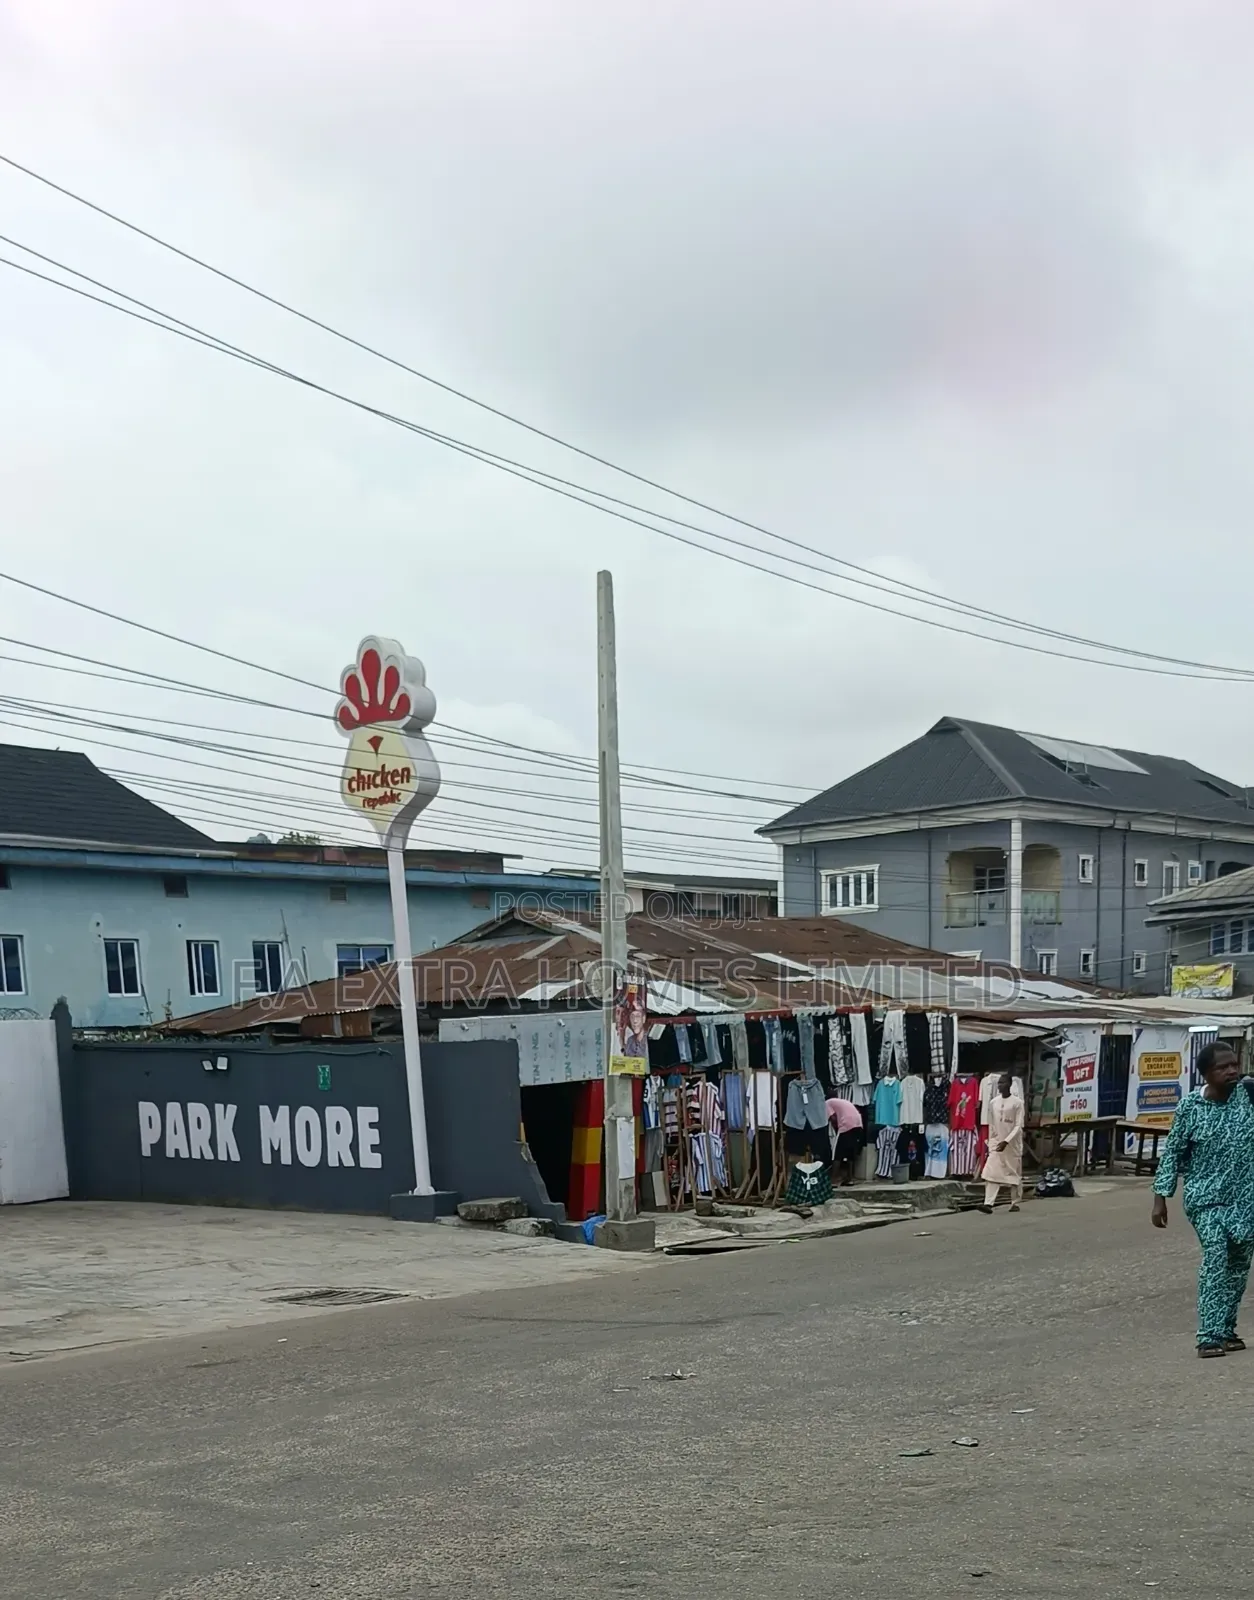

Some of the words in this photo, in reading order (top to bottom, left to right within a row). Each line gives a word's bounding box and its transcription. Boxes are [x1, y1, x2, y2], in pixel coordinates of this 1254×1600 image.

[348, 763, 411, 793] chicken
[362, 789, 402, 810] republic
[1072, 1066, 1090, 1081] 10FT
[138, 1101, 241, 1162] PARK
[259, 1104, 382, 1169] MORE
